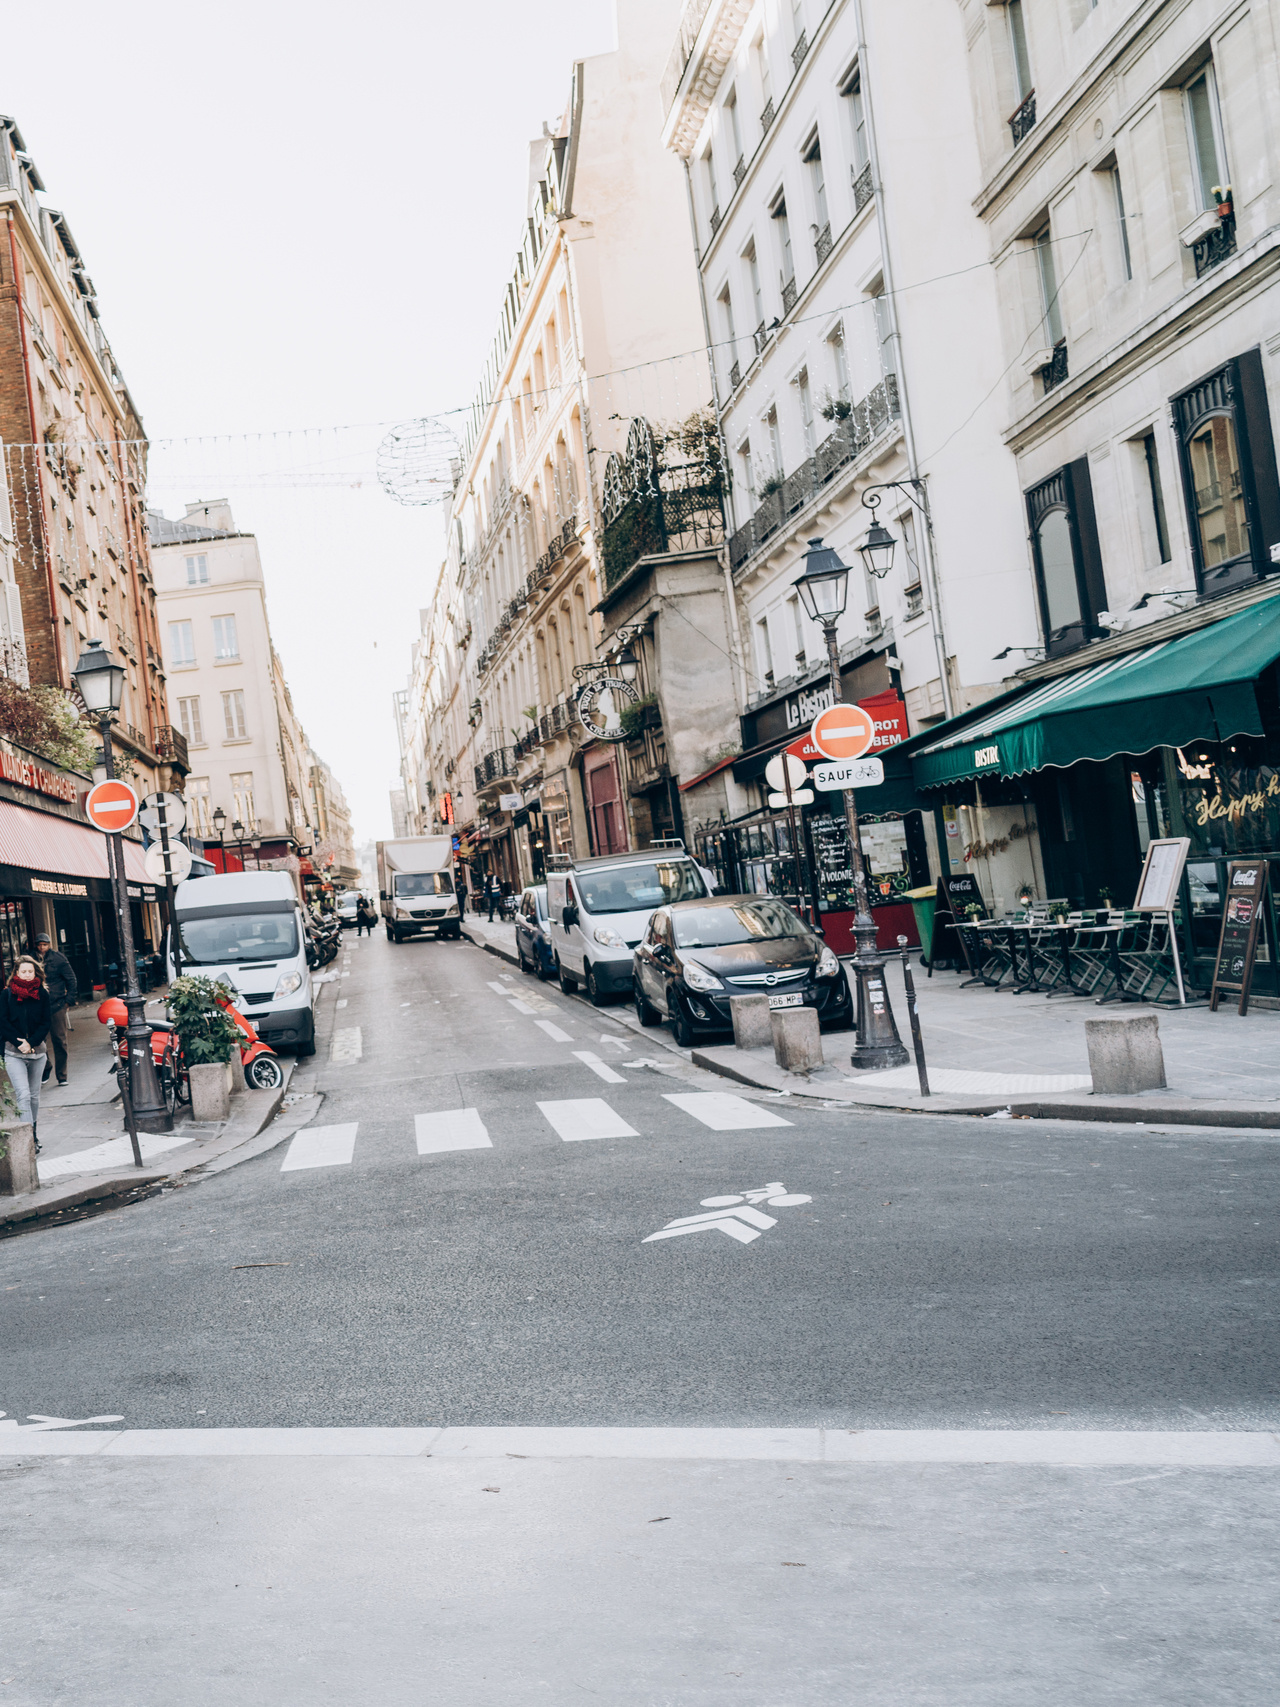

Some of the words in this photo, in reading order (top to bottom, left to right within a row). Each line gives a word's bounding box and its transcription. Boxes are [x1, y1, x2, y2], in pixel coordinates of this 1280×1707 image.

[785, 700, 799, 729] Le
[819, 769, 853, 782] SAUF
[1195, 791, 1265, 826] Happy
